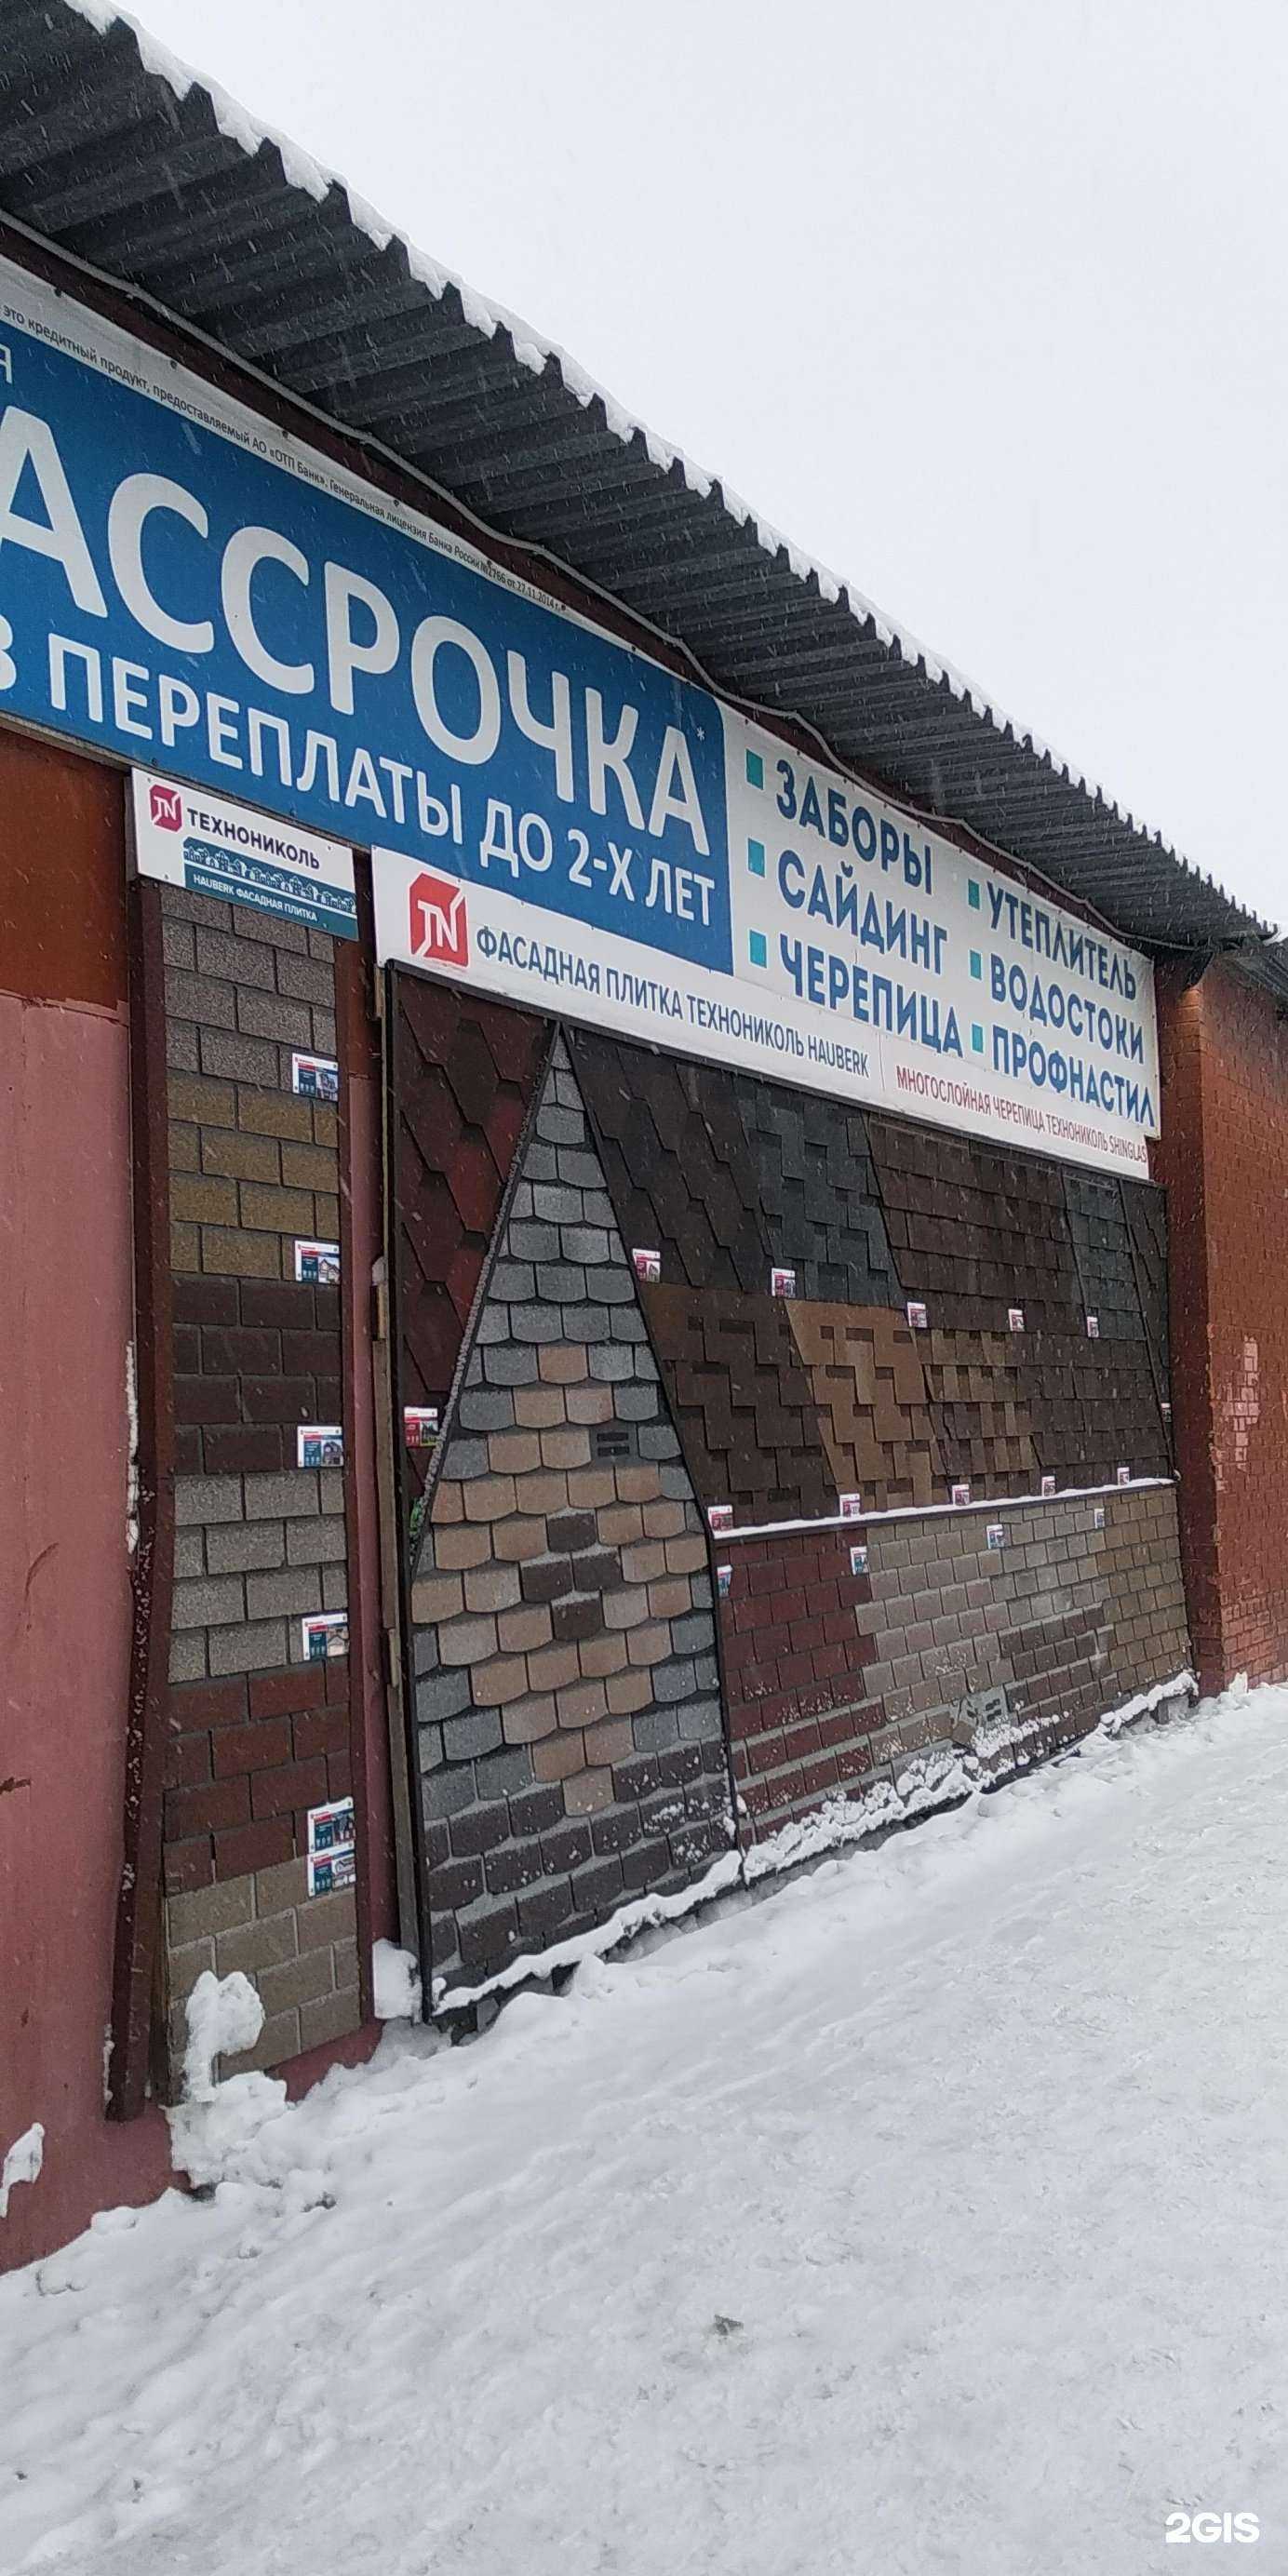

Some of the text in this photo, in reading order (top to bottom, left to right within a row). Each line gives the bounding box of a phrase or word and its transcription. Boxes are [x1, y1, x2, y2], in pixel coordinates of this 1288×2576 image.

[3, 305, 25, 325] это
[28, 316, 98, 363] кредитный
[100, 356, 151, 394] продукт,
[153, 384, 250, 445] предоставляемый
[252, 436, 267, 453] АО
[270, 449, 295, 469] «ОТП
[329, 479, 385, 519] Генеральная
[386, 513, 427, 541] лицензия
[428, 532, 452, 554] Банка
[454, 544, 480, 569] России
[48, 633, 463, 844] ПЕРЕПЛАТЫ
[480, 798, 553, 879] ДО
[567, 828, 634, 902] 2-Х
[645, 866, 715, 928] ЛЕТ
[187, 808, 320, 870] ТЕХНОНИКОЛЬ
[776, 758, 932, 894] ЗАБОРЫ
[194, 874, 317, 922] HAUBERK ФАСАДНАЯ ПЛИТКА
[778, 850, 947, 974] САЙДИНГ
[986, 880, 1136, 1000] УТЕПЛИТЕЛЬ
[477, 926, 869, 1078] ФАСАДНАЯ ПЛИТКА ТЕХНОНИКОЛЬ HAUBERK
[780, 933, 963, 1058] ЧЕРЕПИЦА
[990, 953, 1144, 1064] ВОДОСТОКИ
[896, 1066, 1147, 1162] МНОГОСЛОЙНАЯ ЧЕРЕПИЦА ТЕХНОНИКОЛЬ SHINGLAS
[993, 1025, 1155, 1127] ПРОФНАСТИЛ
